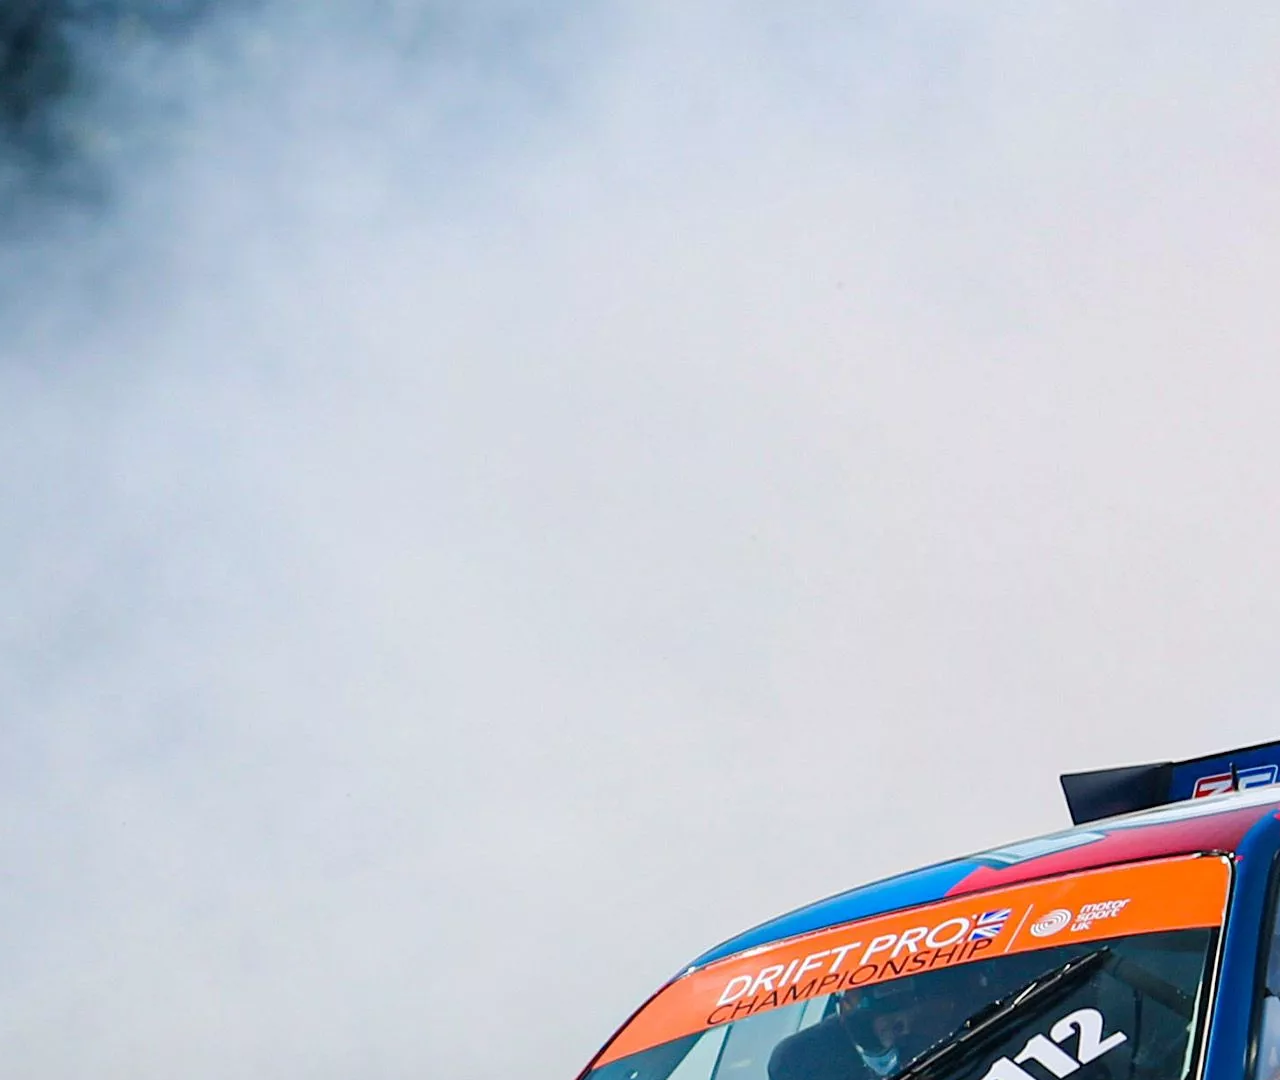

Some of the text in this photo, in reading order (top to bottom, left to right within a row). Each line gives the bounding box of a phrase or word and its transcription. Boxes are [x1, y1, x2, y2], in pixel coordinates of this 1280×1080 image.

[706, 938, 993, 1026] CHAMPIONSHIP
[717, 917, 970, 1007] DRIFT PRO
